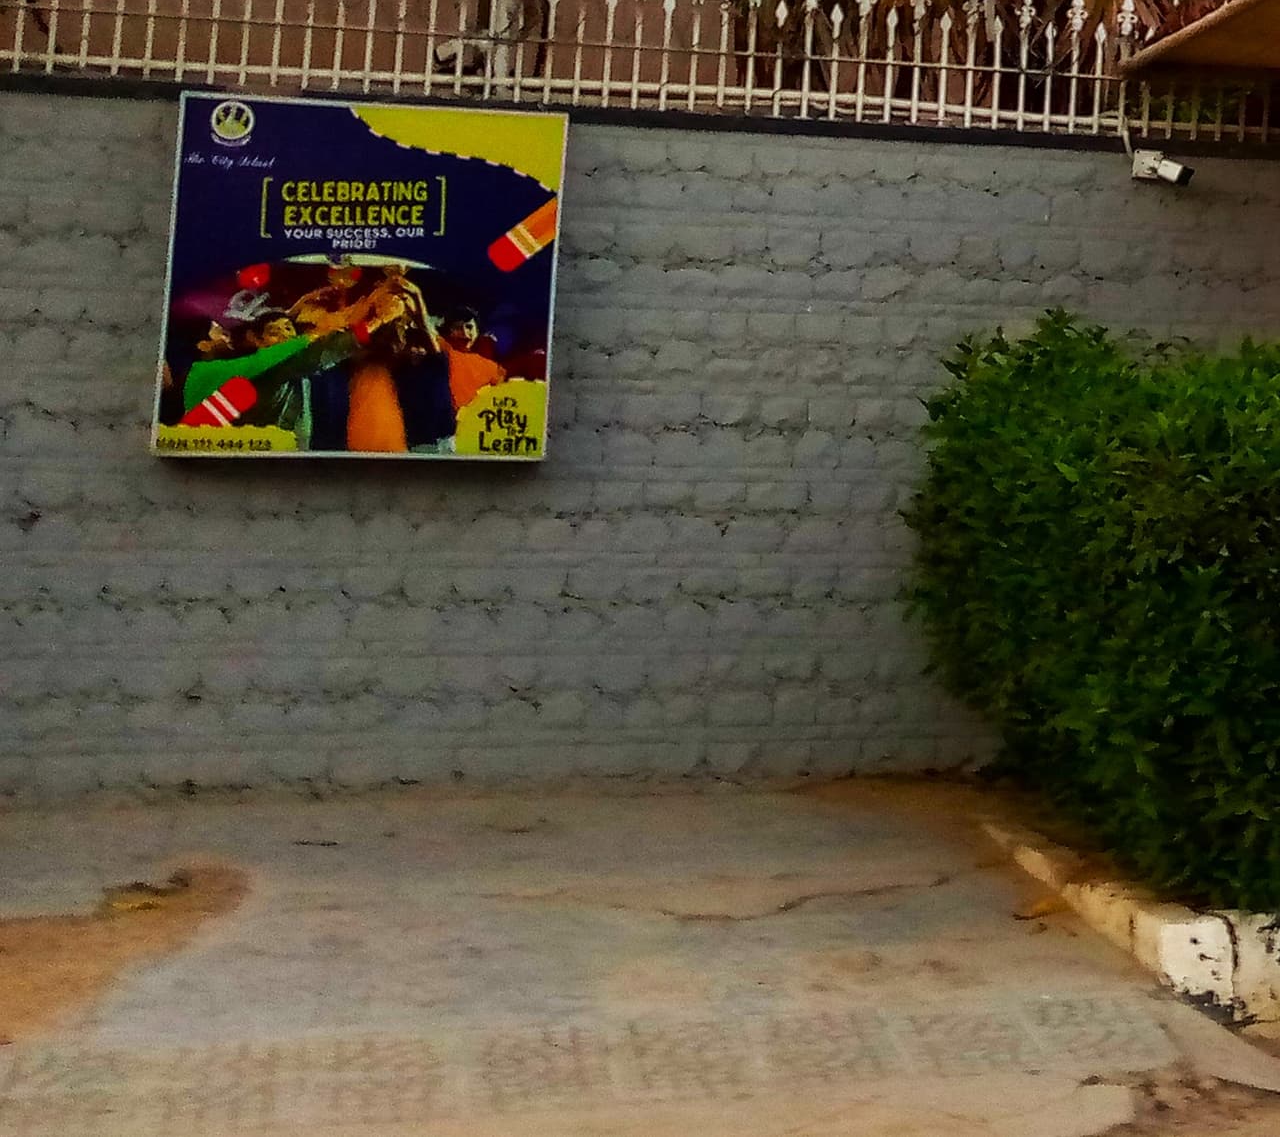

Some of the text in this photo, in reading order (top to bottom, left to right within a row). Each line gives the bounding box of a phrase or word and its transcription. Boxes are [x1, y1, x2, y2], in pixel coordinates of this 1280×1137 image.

[281, 181, 428, 202] CELEBRATING
[283, 205, 425, 226] EXCELLENCE
[284, 228, 323, 239] YOUR
[395, 227, 424, 238] OUR
[477, 408, 528, 434] Play
[478, 430, 538, 454] Learn
